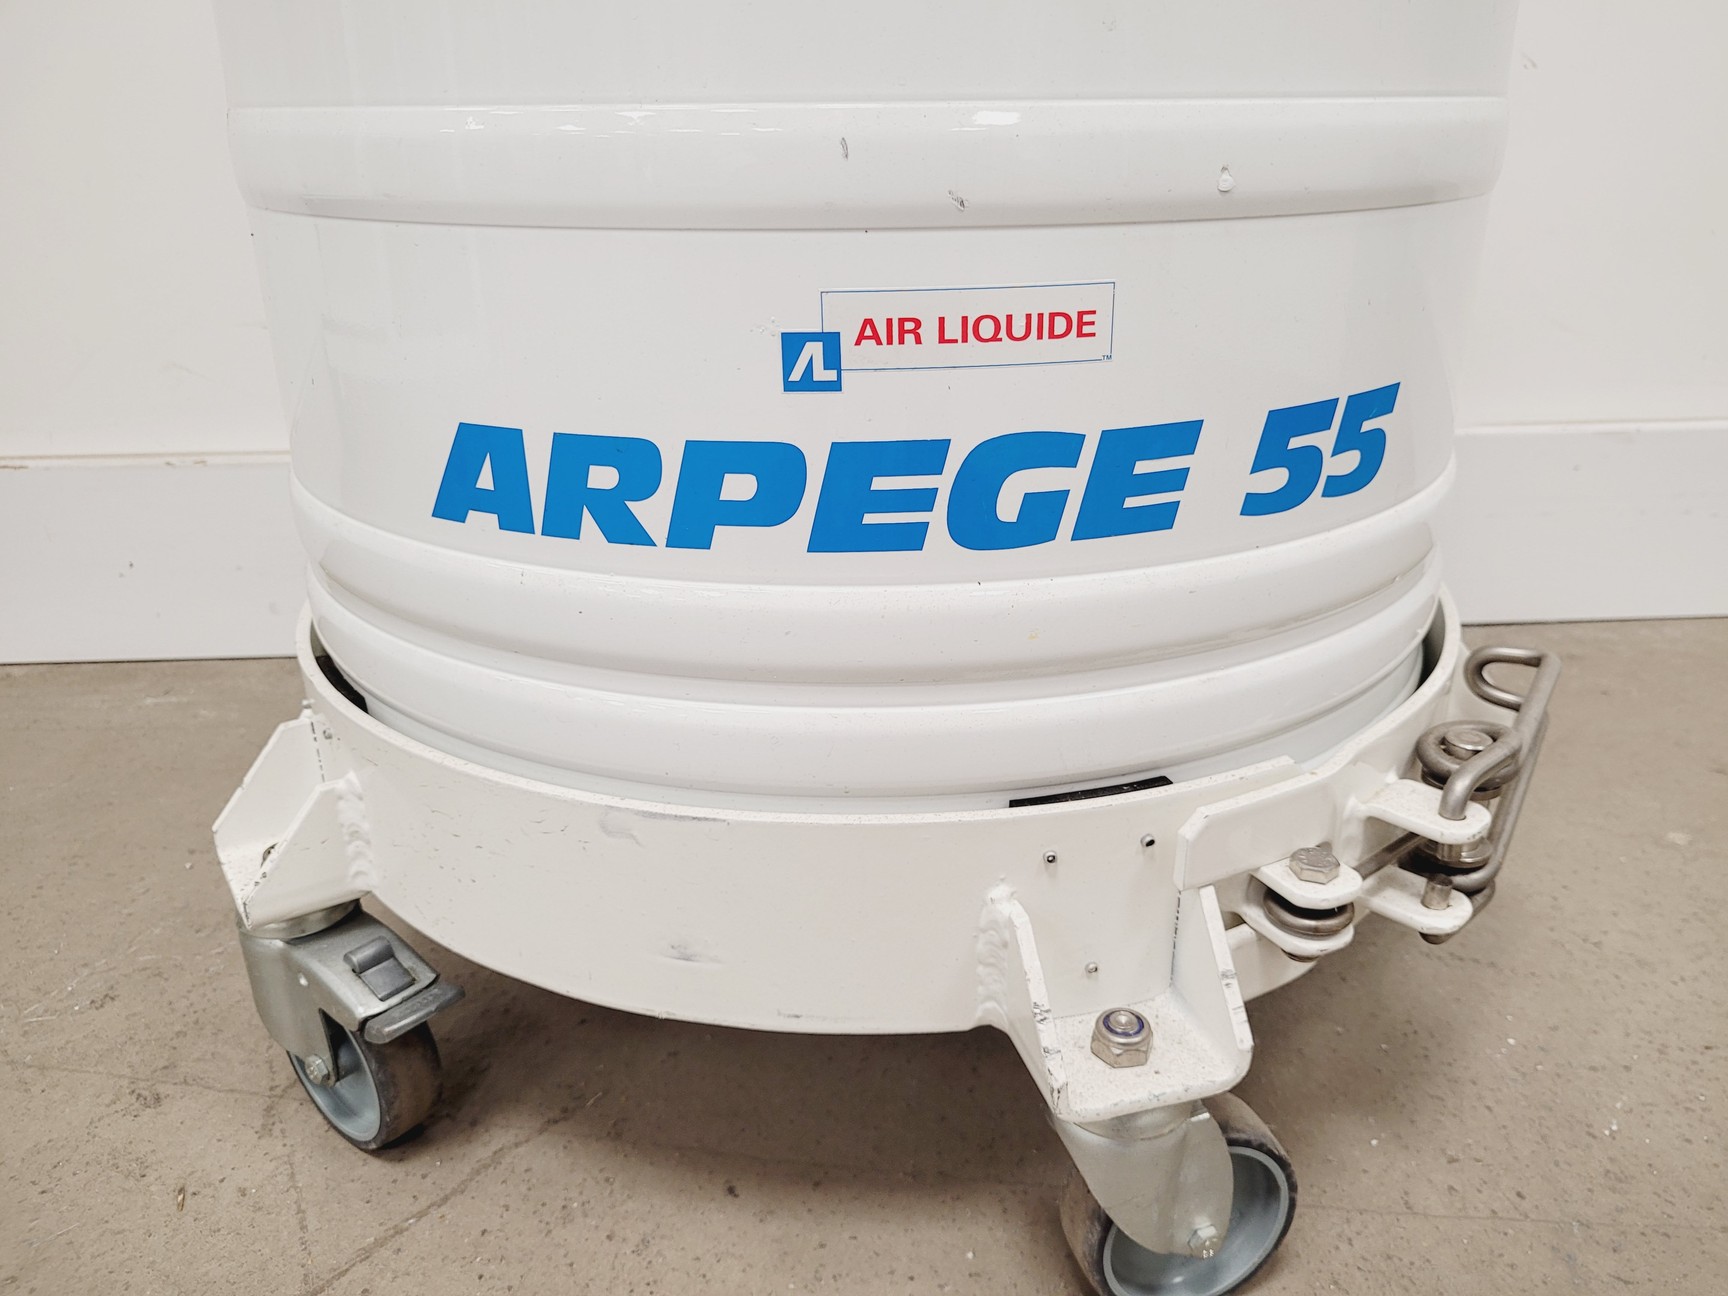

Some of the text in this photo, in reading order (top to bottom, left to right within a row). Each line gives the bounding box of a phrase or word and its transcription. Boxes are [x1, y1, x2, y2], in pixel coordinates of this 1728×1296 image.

[854, 310, 1097, 346] AIR LIQUIDE
[432, 383, 1400, 553] ARPEGE 55
